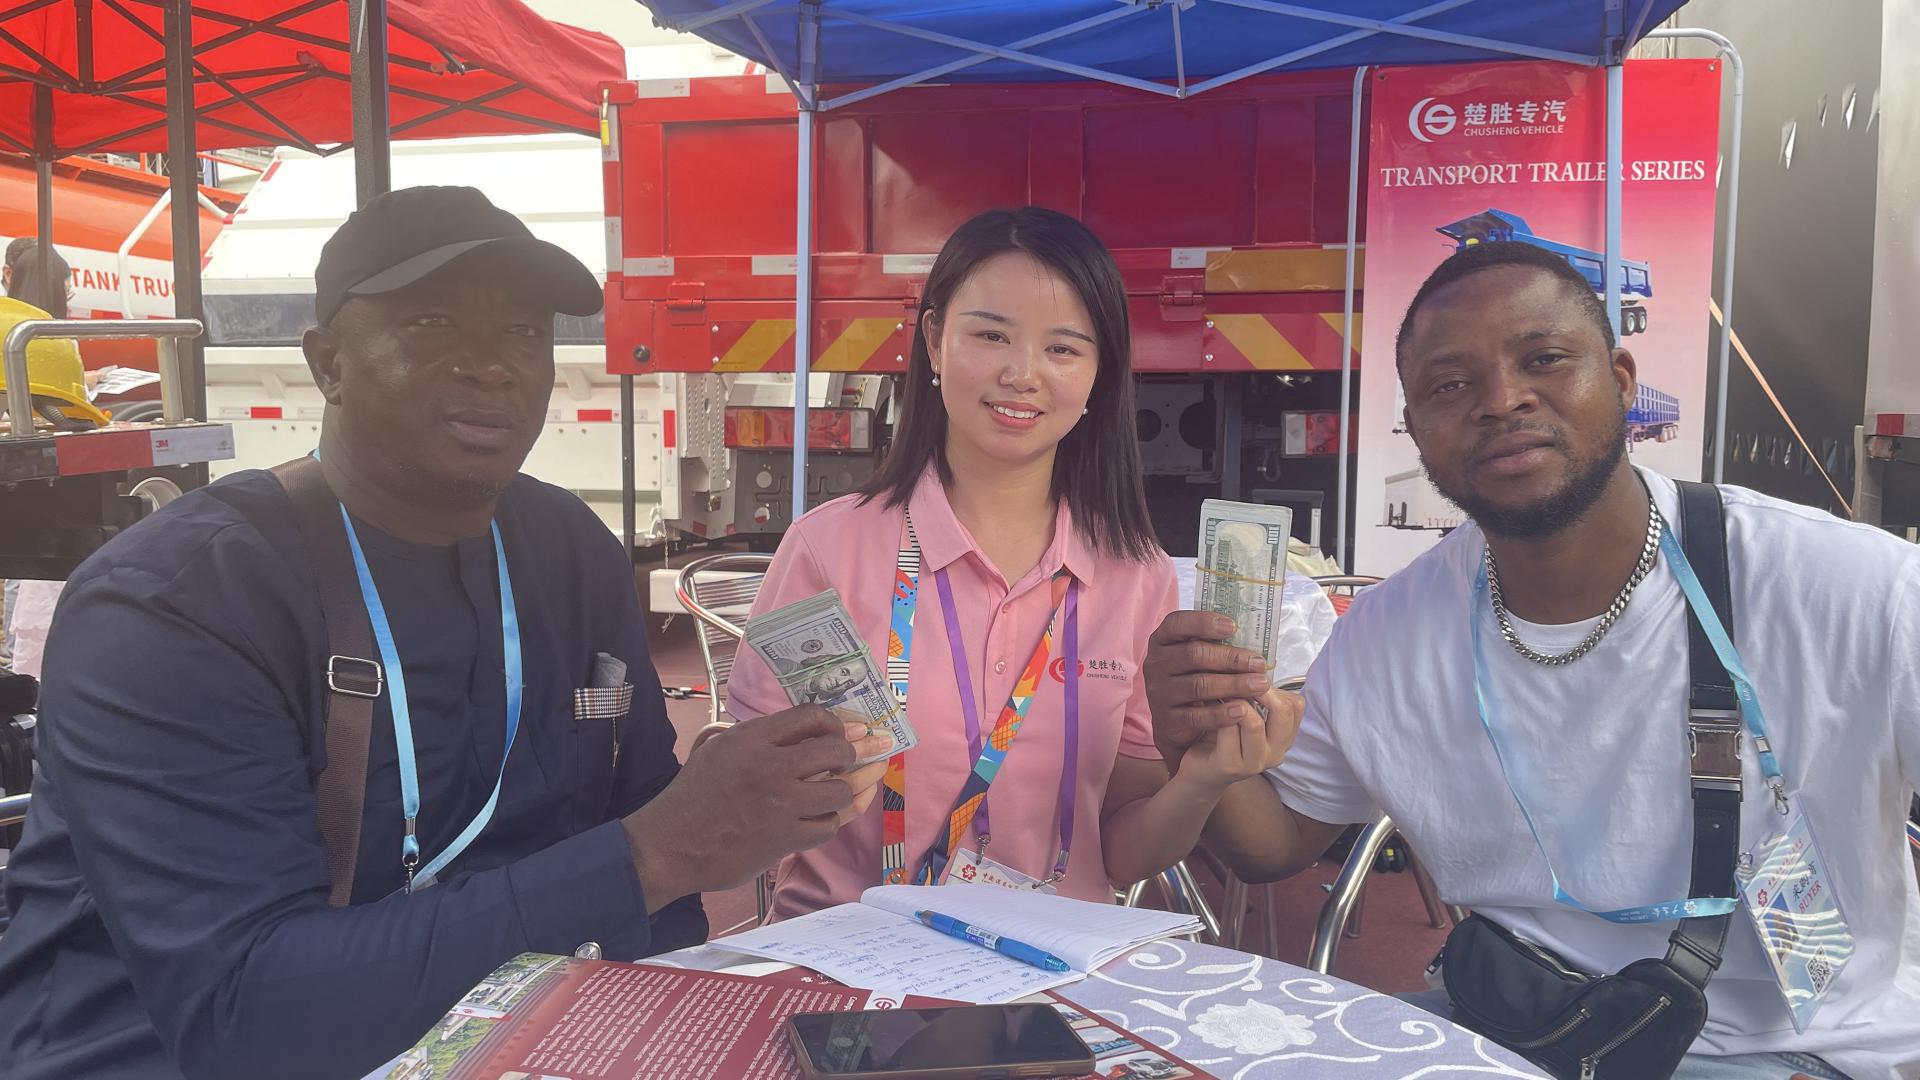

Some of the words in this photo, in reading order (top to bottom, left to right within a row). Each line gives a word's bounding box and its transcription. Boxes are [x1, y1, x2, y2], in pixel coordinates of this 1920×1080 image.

[1463, 100, 1567, 126] 楚胜专汽
[1463, 126, 1520, 137] CHUSHENG
[1522, 124, 1565, 135] VEHICLE
[1381, 163, 1522, 188] TRANSPORT
[1631, 159, 1705, 182] SERIES
[155, 439, 169, 448] 3M
[1266, 526, 1280, 545] 100
[892, 722, 907, 744] 100
[1799, 879, 1822, 914] BUYER
